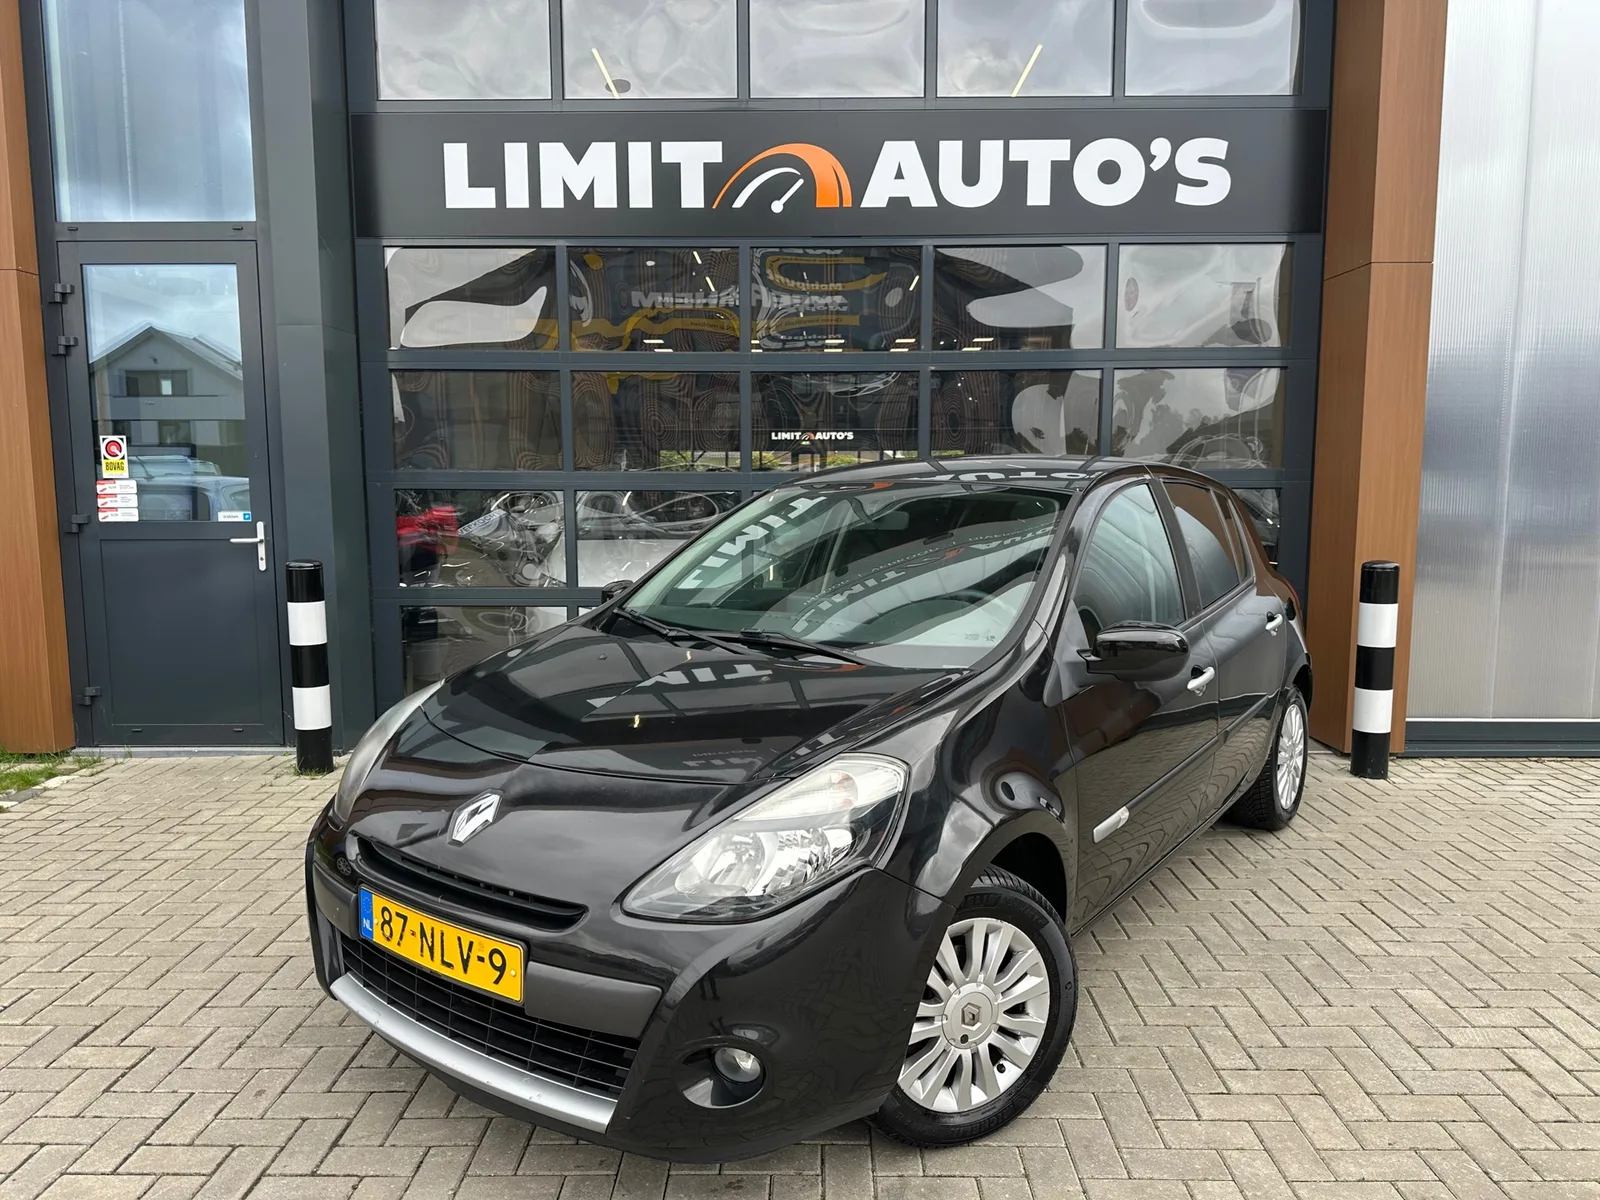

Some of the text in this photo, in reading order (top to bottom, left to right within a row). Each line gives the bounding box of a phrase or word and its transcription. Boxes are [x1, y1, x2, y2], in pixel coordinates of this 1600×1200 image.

[443, 137, 1232, 209] LIMIT AUTO'S
[771, 431, 854, 440] LIMIT AUTO'S
[105, 461, 124, 471] BOVAG
[362, 918, 373, 931] NL
[380, 906, 507, 985] 87-NLV-9
